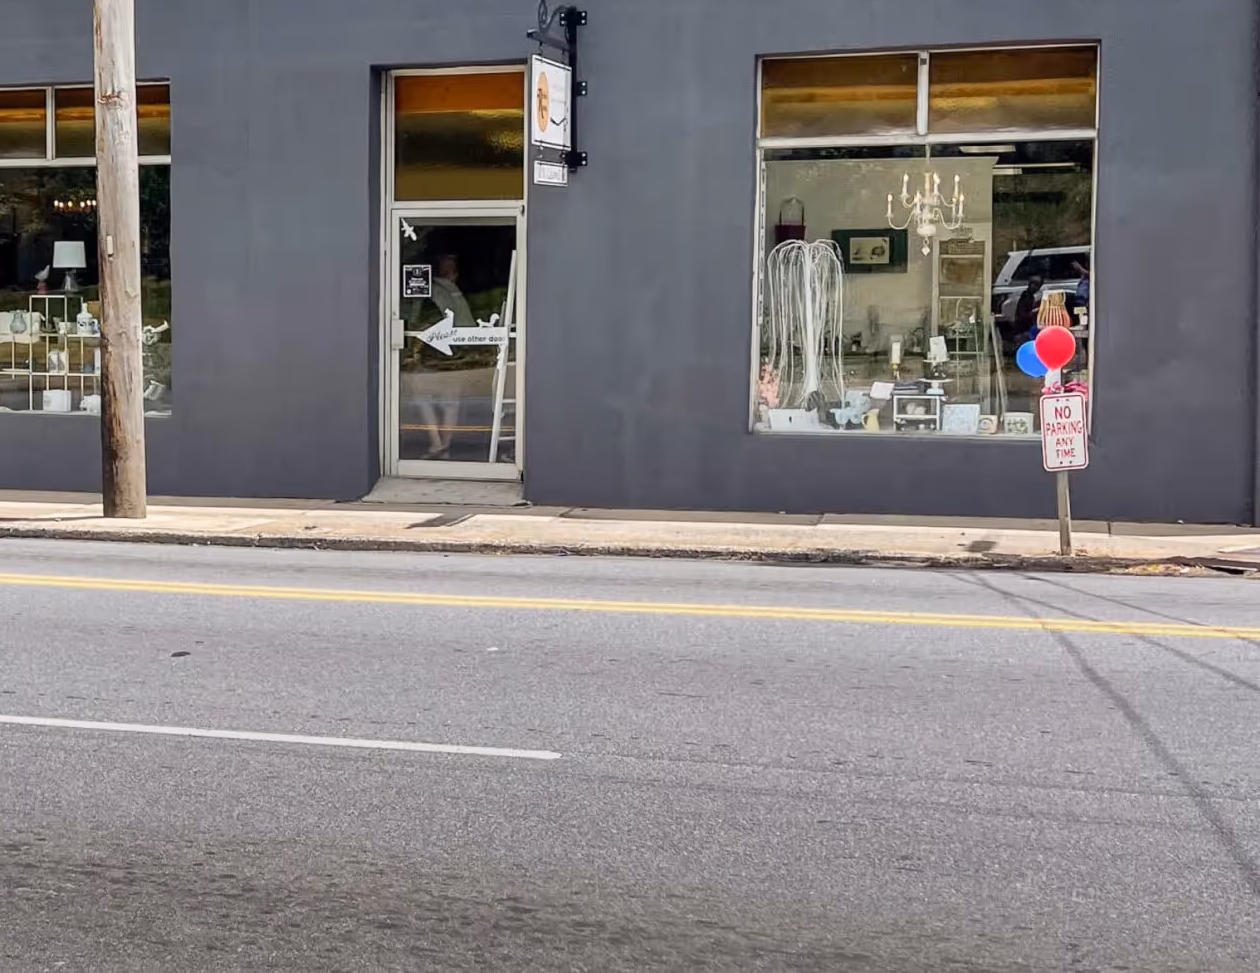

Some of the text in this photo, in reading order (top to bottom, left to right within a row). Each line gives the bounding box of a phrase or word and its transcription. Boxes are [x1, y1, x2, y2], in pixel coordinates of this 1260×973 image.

[467, 335, 486, 343] other
[1054, 406, 1071, 420] NO
[1046, 420, 1083, 436] PARKING
[1056, 437, 1074, 447] ANY
[1056, 448, 1076, 458] TIME
